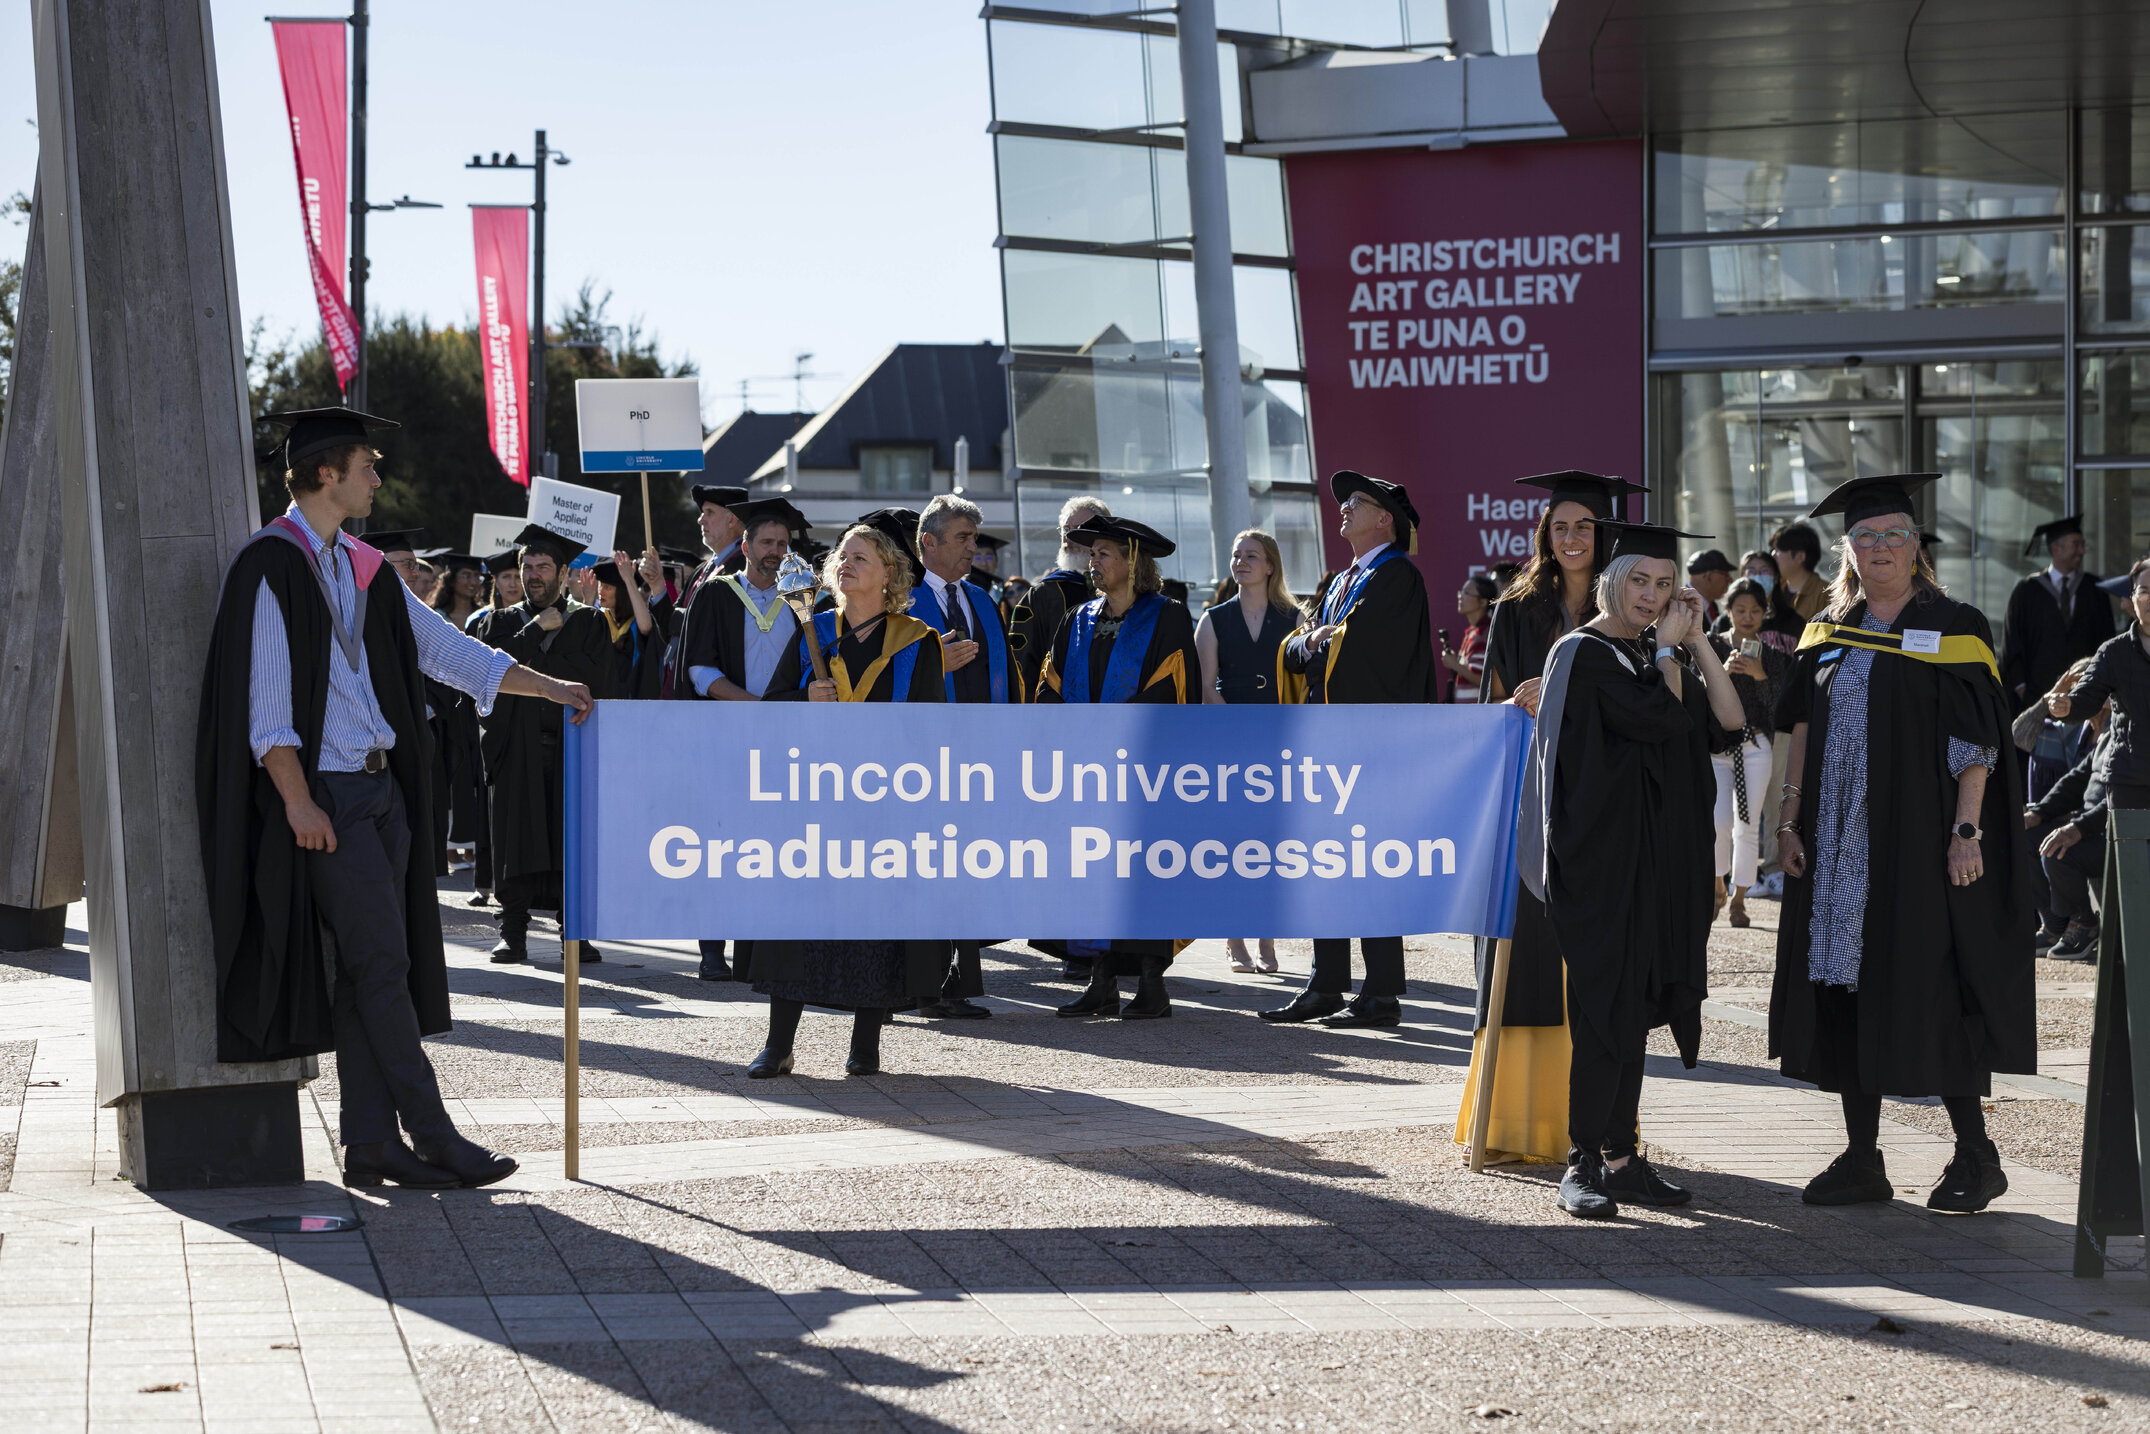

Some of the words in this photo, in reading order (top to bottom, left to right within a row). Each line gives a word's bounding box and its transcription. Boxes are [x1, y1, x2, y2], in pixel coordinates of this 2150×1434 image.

[1349, 232, 1620, 275] CHRISTCHURCH
[484, 276, 499, 337] GALLERY
[1348, 280, 1418, 313] ART
[1424, 273, 1582, 310] GALLERY
[1348, 320, 1389, 351] TE
[1398, 316, 1495, 350] PUNA
[1499, 314, 1526, 346] O
[490, 339, 504, 367] ART
[1348, 344, 1549, 389] WAIWHETŪ
[494, 367, 508, 470] HRISTCHURCH
[629, 411, 650, 420] PhD
[508, 417, 519, 460] PUNA
[508, 460, 519, 476] TE
[552, 496, 582, 510] Master
[583, 503, 593, 513] of
[553, 510, 588, 526] Applied
[544, 522, 593, 543] Computing
[750, 746, 994, 802] Lincoln
[1022, 748, 1361, 815] University
[649, 824, 1048, 879] Graduation
[1071, 824, 1456, 879] Procession
